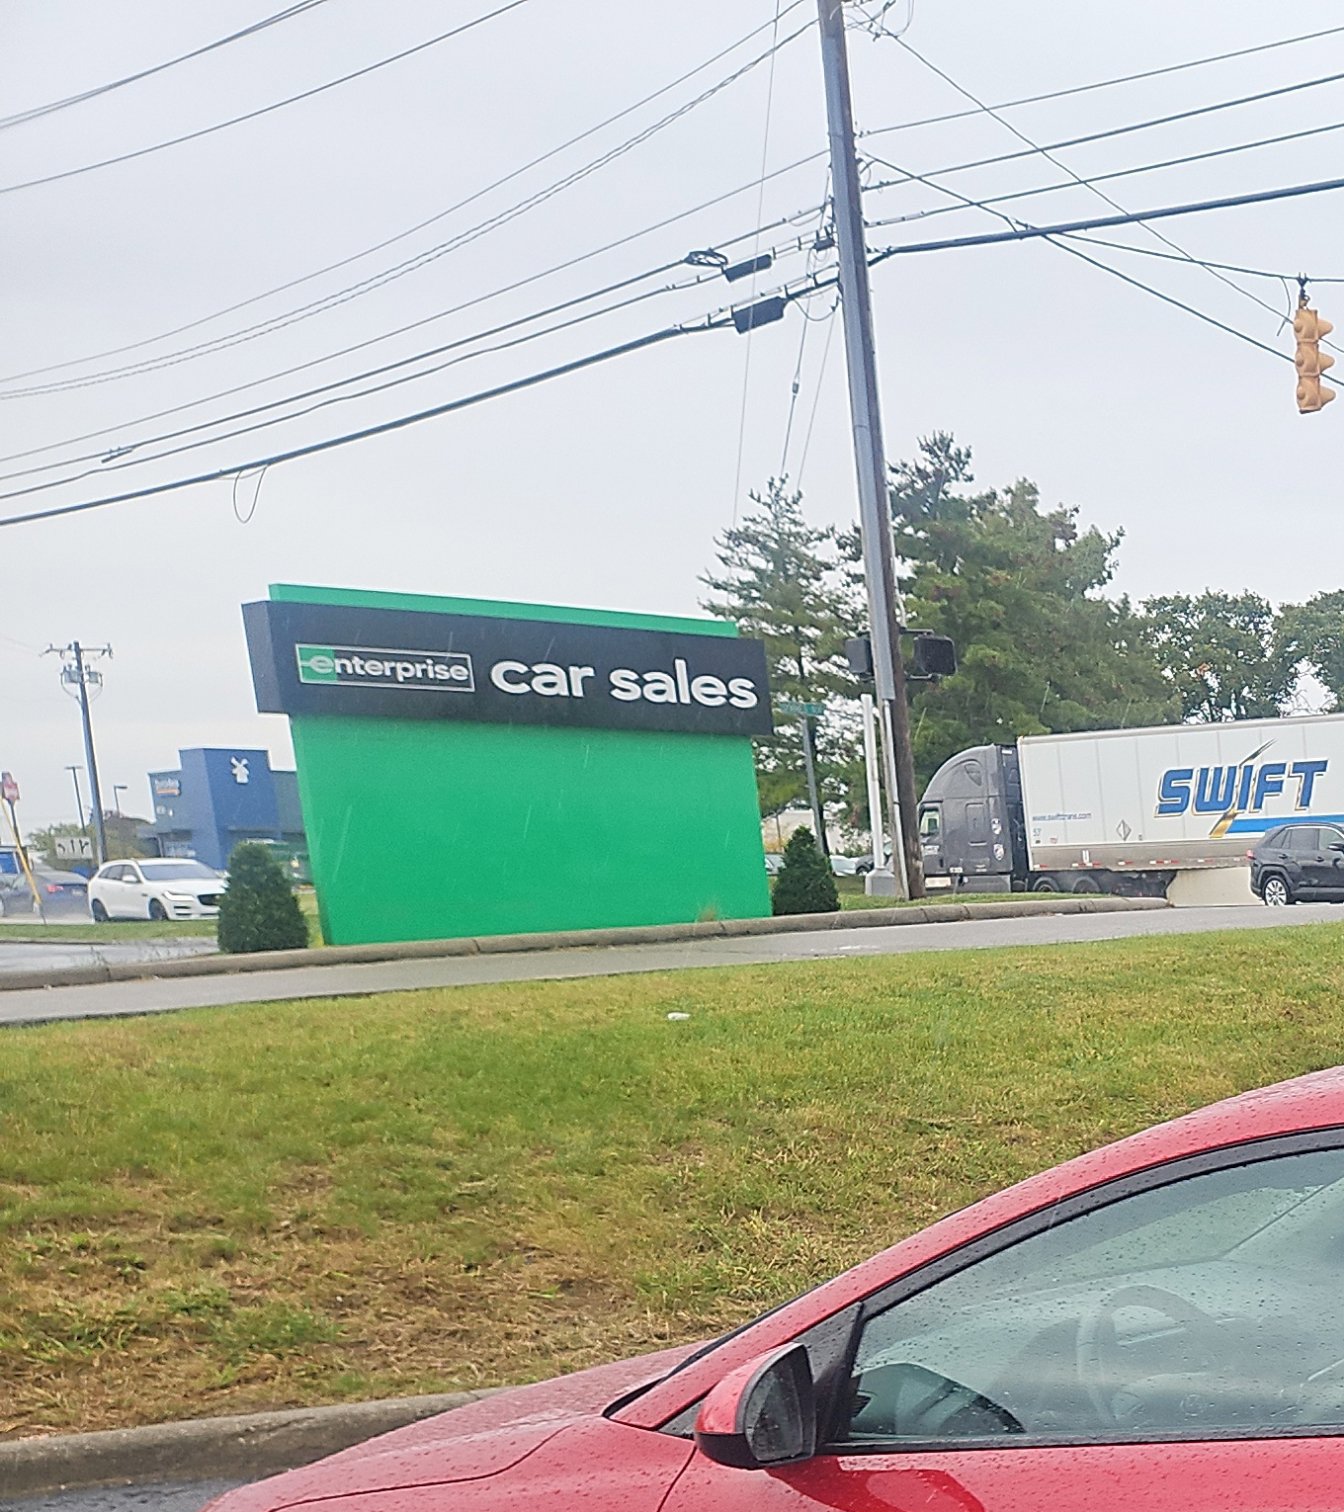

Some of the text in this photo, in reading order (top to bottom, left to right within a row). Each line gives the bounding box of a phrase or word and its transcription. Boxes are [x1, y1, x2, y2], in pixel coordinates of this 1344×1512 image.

[305, 654, 758, 709] enterprise car sales
[1154, 760, 1329, 818] SWIFT
